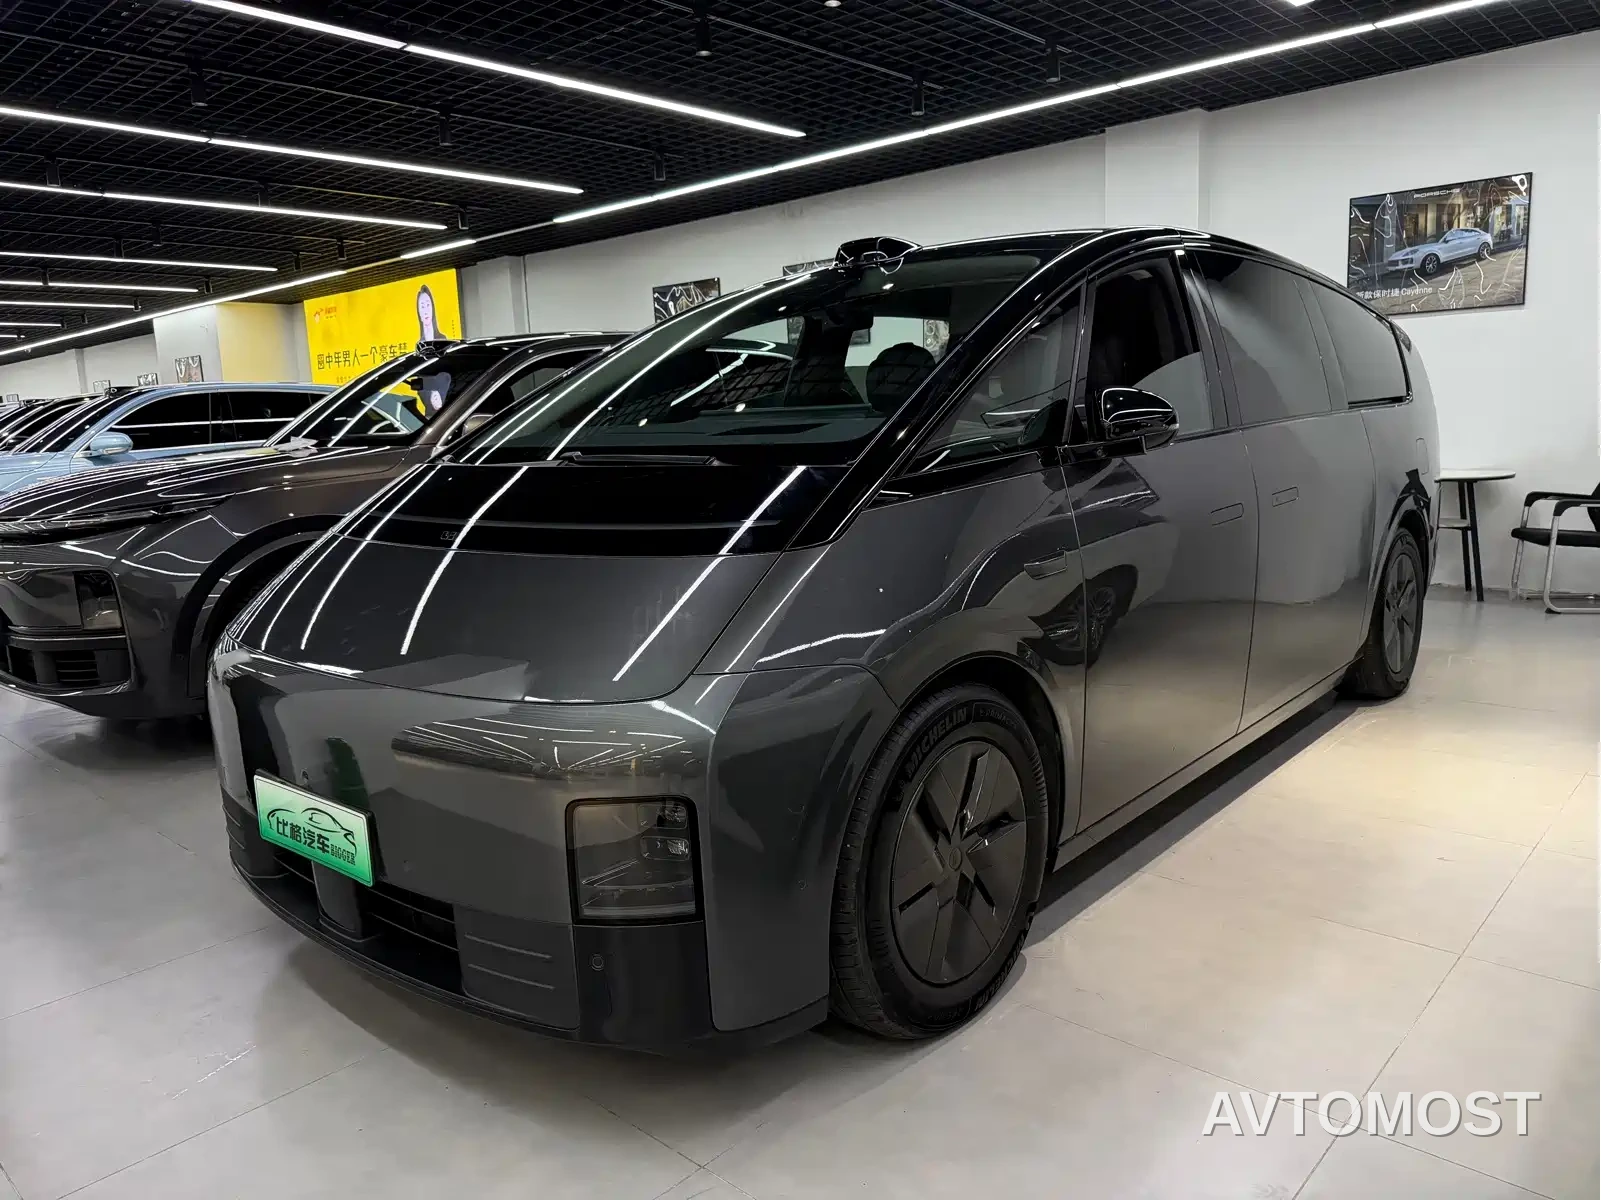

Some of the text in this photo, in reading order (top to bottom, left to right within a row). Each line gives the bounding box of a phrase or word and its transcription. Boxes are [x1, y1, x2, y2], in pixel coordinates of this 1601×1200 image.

[1414, 188, 1460, 199] PORSCHE
[1401, 287, 1433, 297] Cayenne
[904, 707, 968, 780] MICHELIN
[276, 816, 356, 866] 比格汽车 BIGGER
